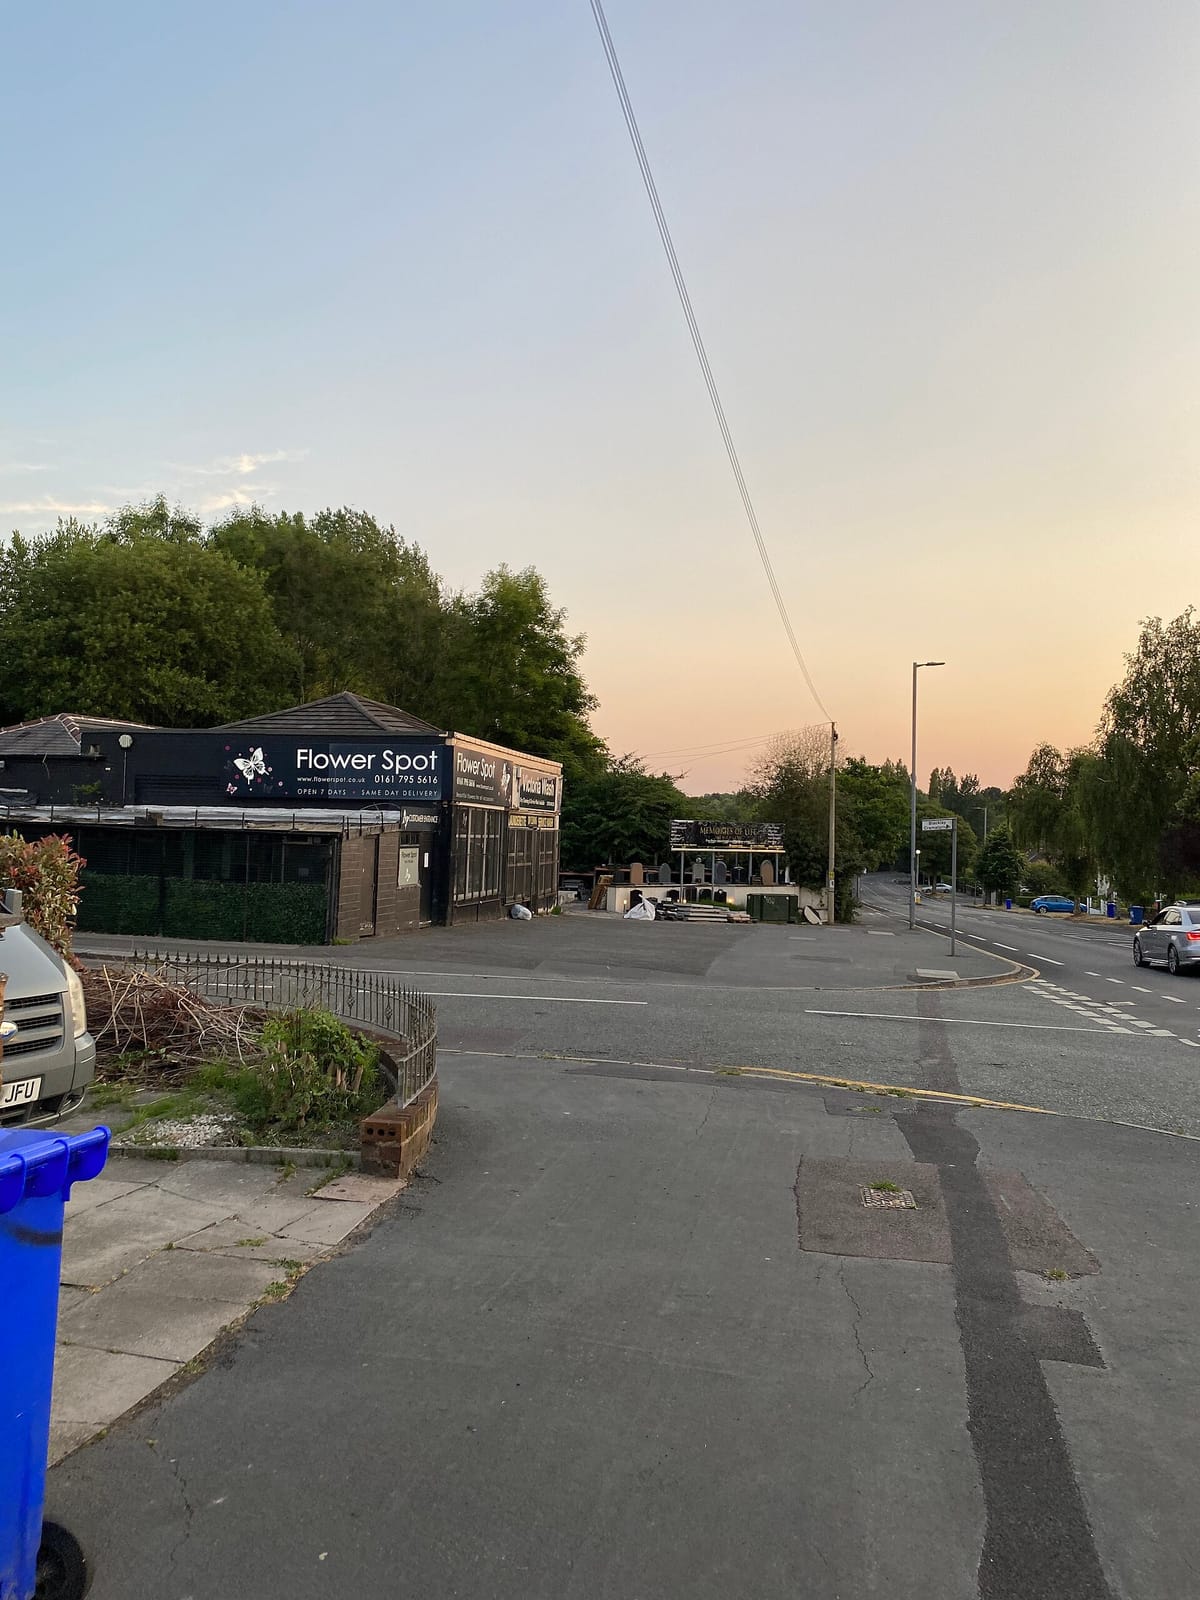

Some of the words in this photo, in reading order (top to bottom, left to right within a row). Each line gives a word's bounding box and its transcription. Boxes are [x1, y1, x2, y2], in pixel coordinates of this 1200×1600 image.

[296, 749, 376, 769] Flower
[381, 750, 438, 774] Spot
[457, 752, 480, 775] Flower
[480, 757, 496, 780] Spot
[297, 776, 366, 784] www.flowerspot.co.uk
[374, 774, 395, 784] 0161
[398, 775, 414, 784] 795
[417, 775, 438, 784] 5616
[522, 774, 541, 794] Victoria
[541, 777, 555, 796] Wash
[700, 826, 733, 835] MEMORIES
[735, 827, 743, 835] OF
[744, 828, 757, 836] LIFE
[5, 1081, 34, 1102] JFU
